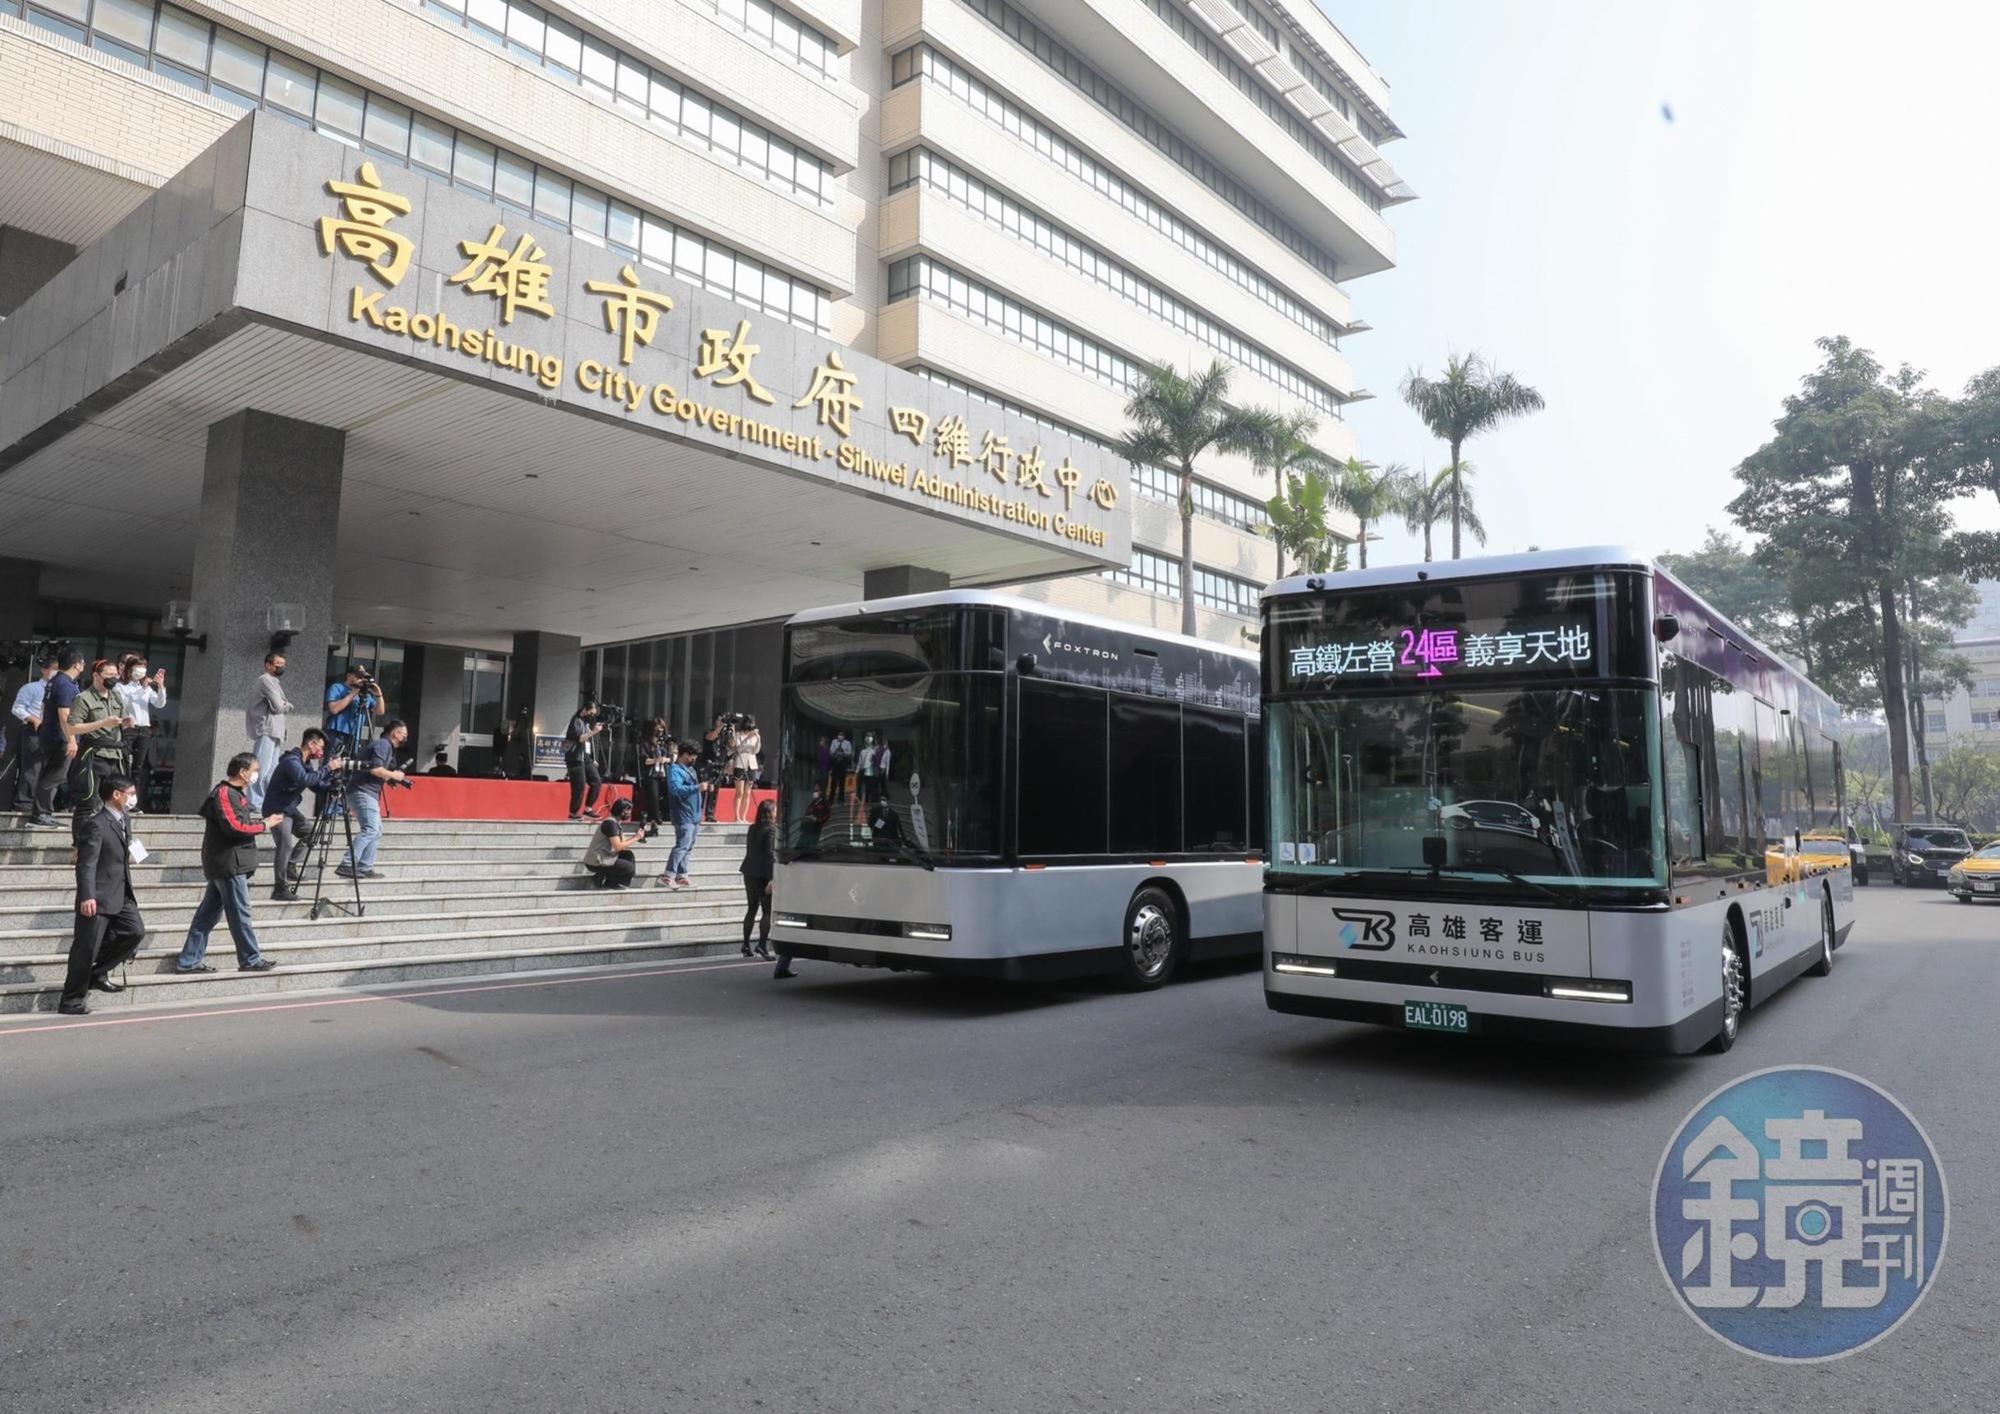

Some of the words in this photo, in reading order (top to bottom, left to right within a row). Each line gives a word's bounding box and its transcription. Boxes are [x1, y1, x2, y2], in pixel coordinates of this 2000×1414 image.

[317, 161, 863, 437] 高雄市政府
[889, 406, 1119, 510] 四維行政中心
[351, 286, 564, 389] Kaohsiung
[578, 359, 646, 411] City
[652, 383, 822, 462] Government
[837, 441, 909, 488] Sihwei
[911, 469, 1049, 531] Administration
[1053, 512, 1108, 548] Center
[1054, 641, 1119, 660] FOXTRON
[1290, 640, 1396, 677] 高鐵左營
[1400, 628, 1459, 665] 24區
[1464, 624, 1592, 668] 義享天地
[1408, 913, 1544, 946] 高雄客運
[1407, 943, 1505, 960] KAOHSIUNG
[1513, 951, 1545, 963] BUS
